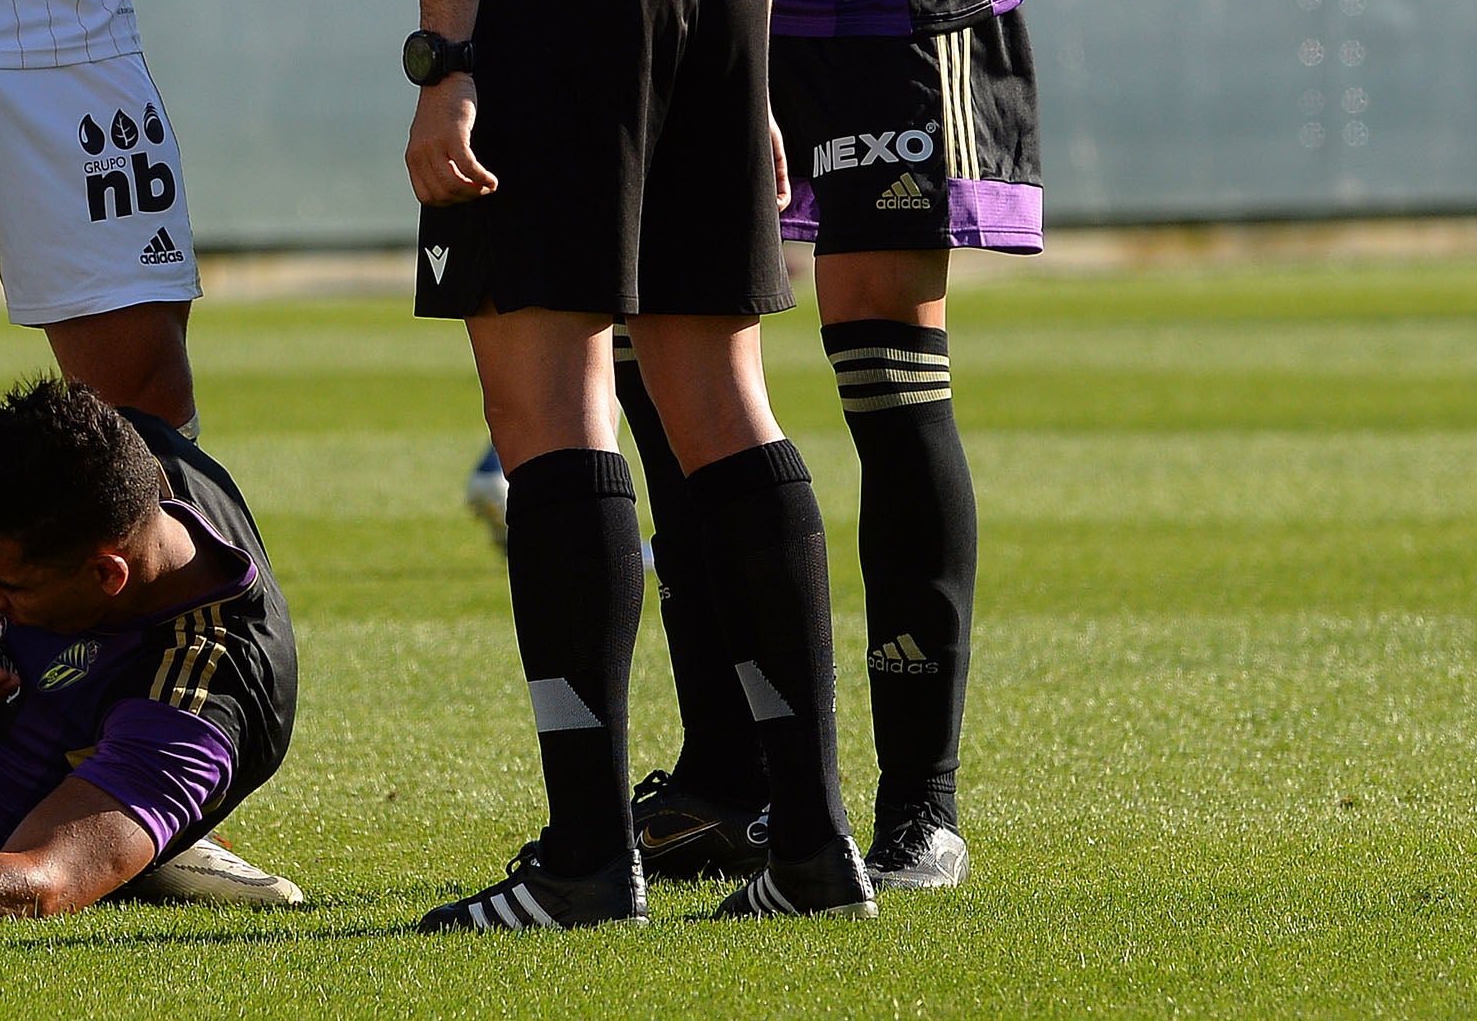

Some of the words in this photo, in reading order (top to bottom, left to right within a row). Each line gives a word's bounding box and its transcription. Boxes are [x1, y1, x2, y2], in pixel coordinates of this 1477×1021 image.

[84, 156, 126, 174] GRUPO
[86, 152, 176, 222] nb
[876, 195, 931, 210] adidas
[140, 251, 184, 264] adidas
[868, 657, 939, 674] adidas
